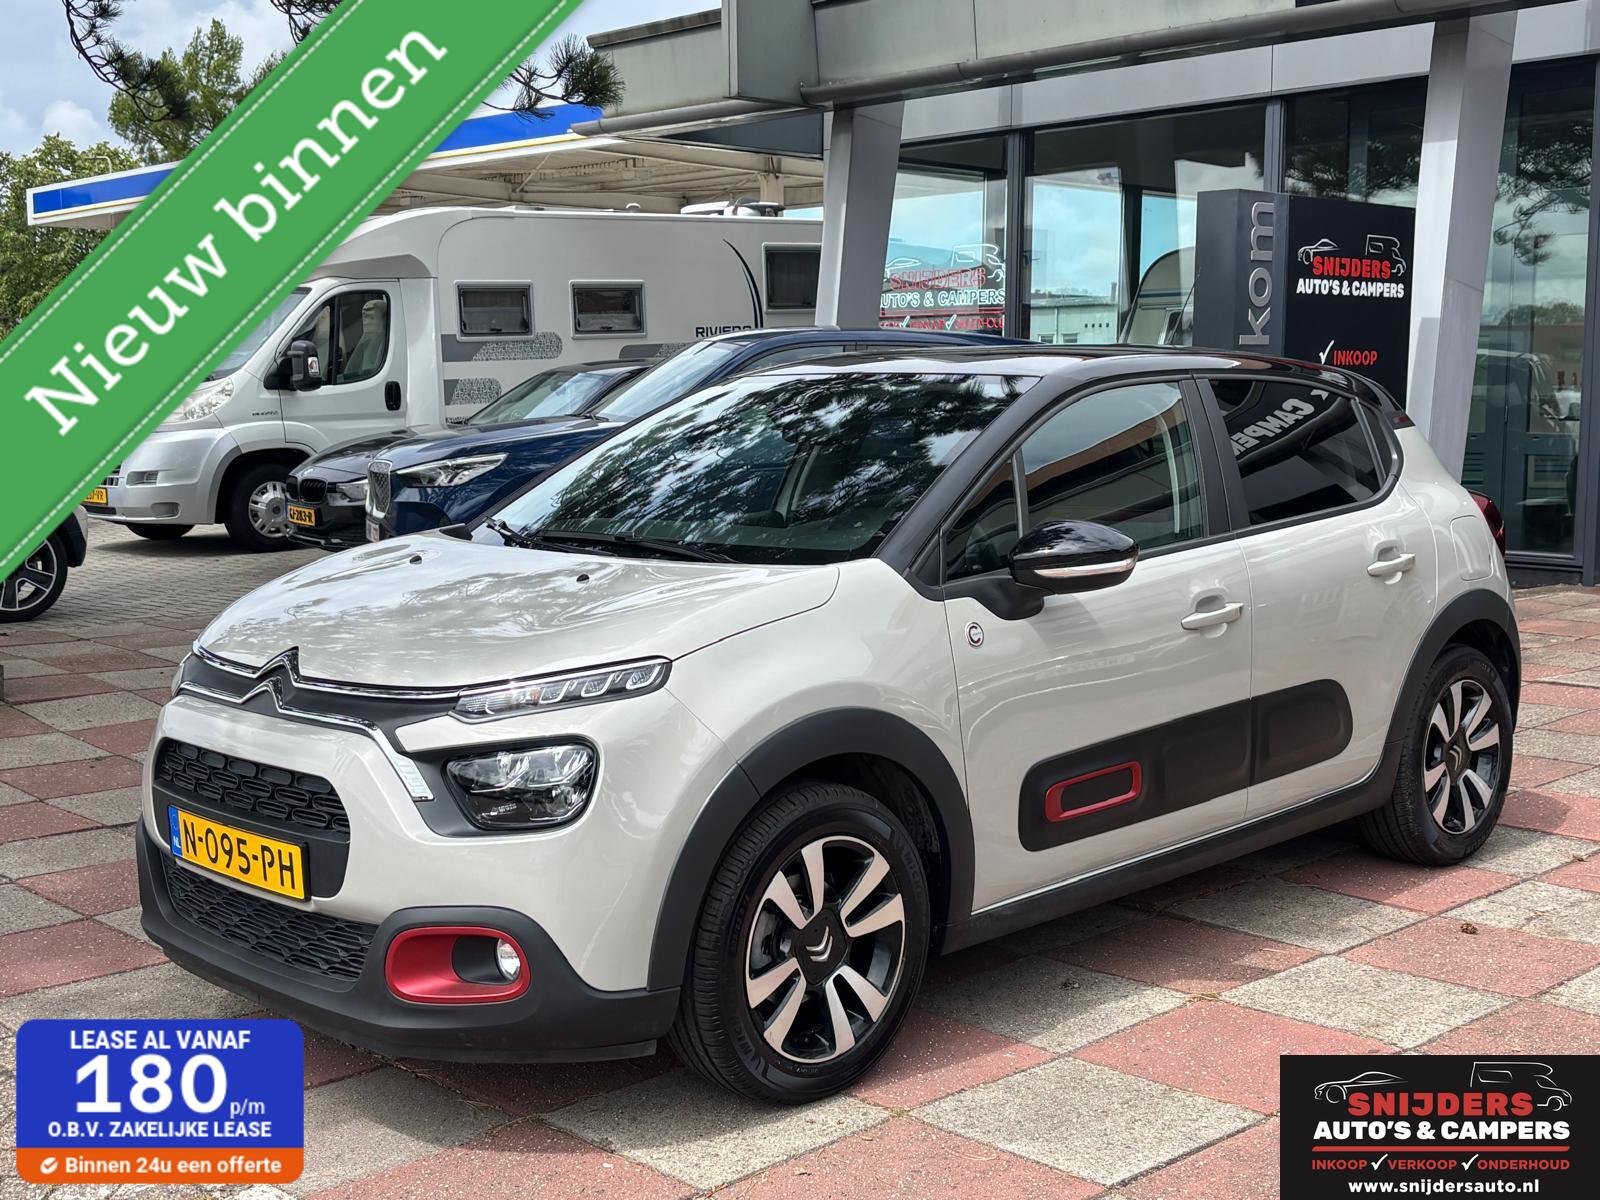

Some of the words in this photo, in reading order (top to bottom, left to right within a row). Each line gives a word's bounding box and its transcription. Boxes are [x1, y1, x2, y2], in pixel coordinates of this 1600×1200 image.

[1239, 202, 1274, 345] kom
[1313, 256, 1391, 279] SNIJDERS
[1296, 278, 1340, 295] AUTO'S
[1341, 280, 1350, 296] &
[1352, 281, 1404, 298] CAMPERS
[880, 293, 920, 309] UTO'S
[923, 292, 935, 307] &
[938, 289, 1005, 306] CAMPERS
[1333, 350, 1378, 366] INKOOP
[183, 818, 296, 889] N-095-PH
